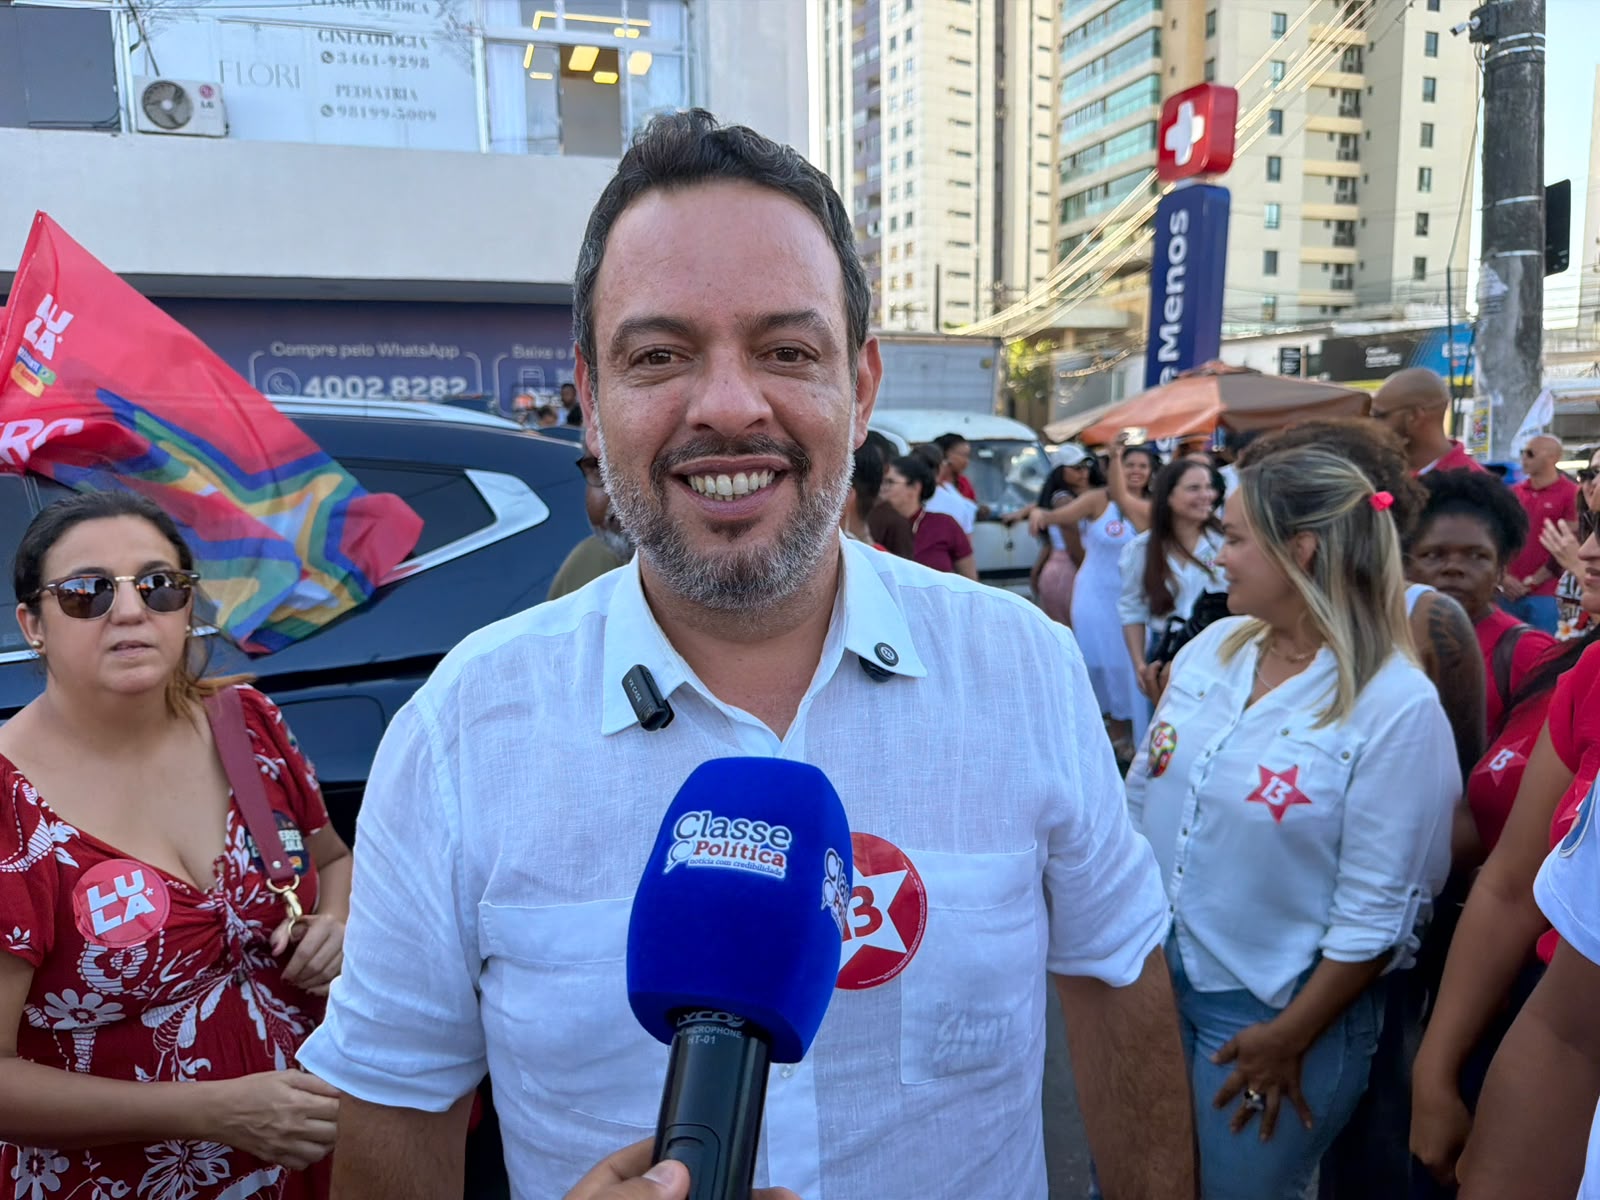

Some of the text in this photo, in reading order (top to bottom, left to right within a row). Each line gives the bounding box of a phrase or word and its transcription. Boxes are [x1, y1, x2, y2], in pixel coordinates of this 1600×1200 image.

[1158, 208, 1189, 362] Menos
[270, 341, 459, 360] Compre pelo WhatsApp
[302, 375, 468, 399] 4002 8282
[1488, 748, 1515, 771] 13
[1261, 775, 1294, 806] 13
[675, 812, 791, 848] Classe
[693, 840, 785, 868] Política
